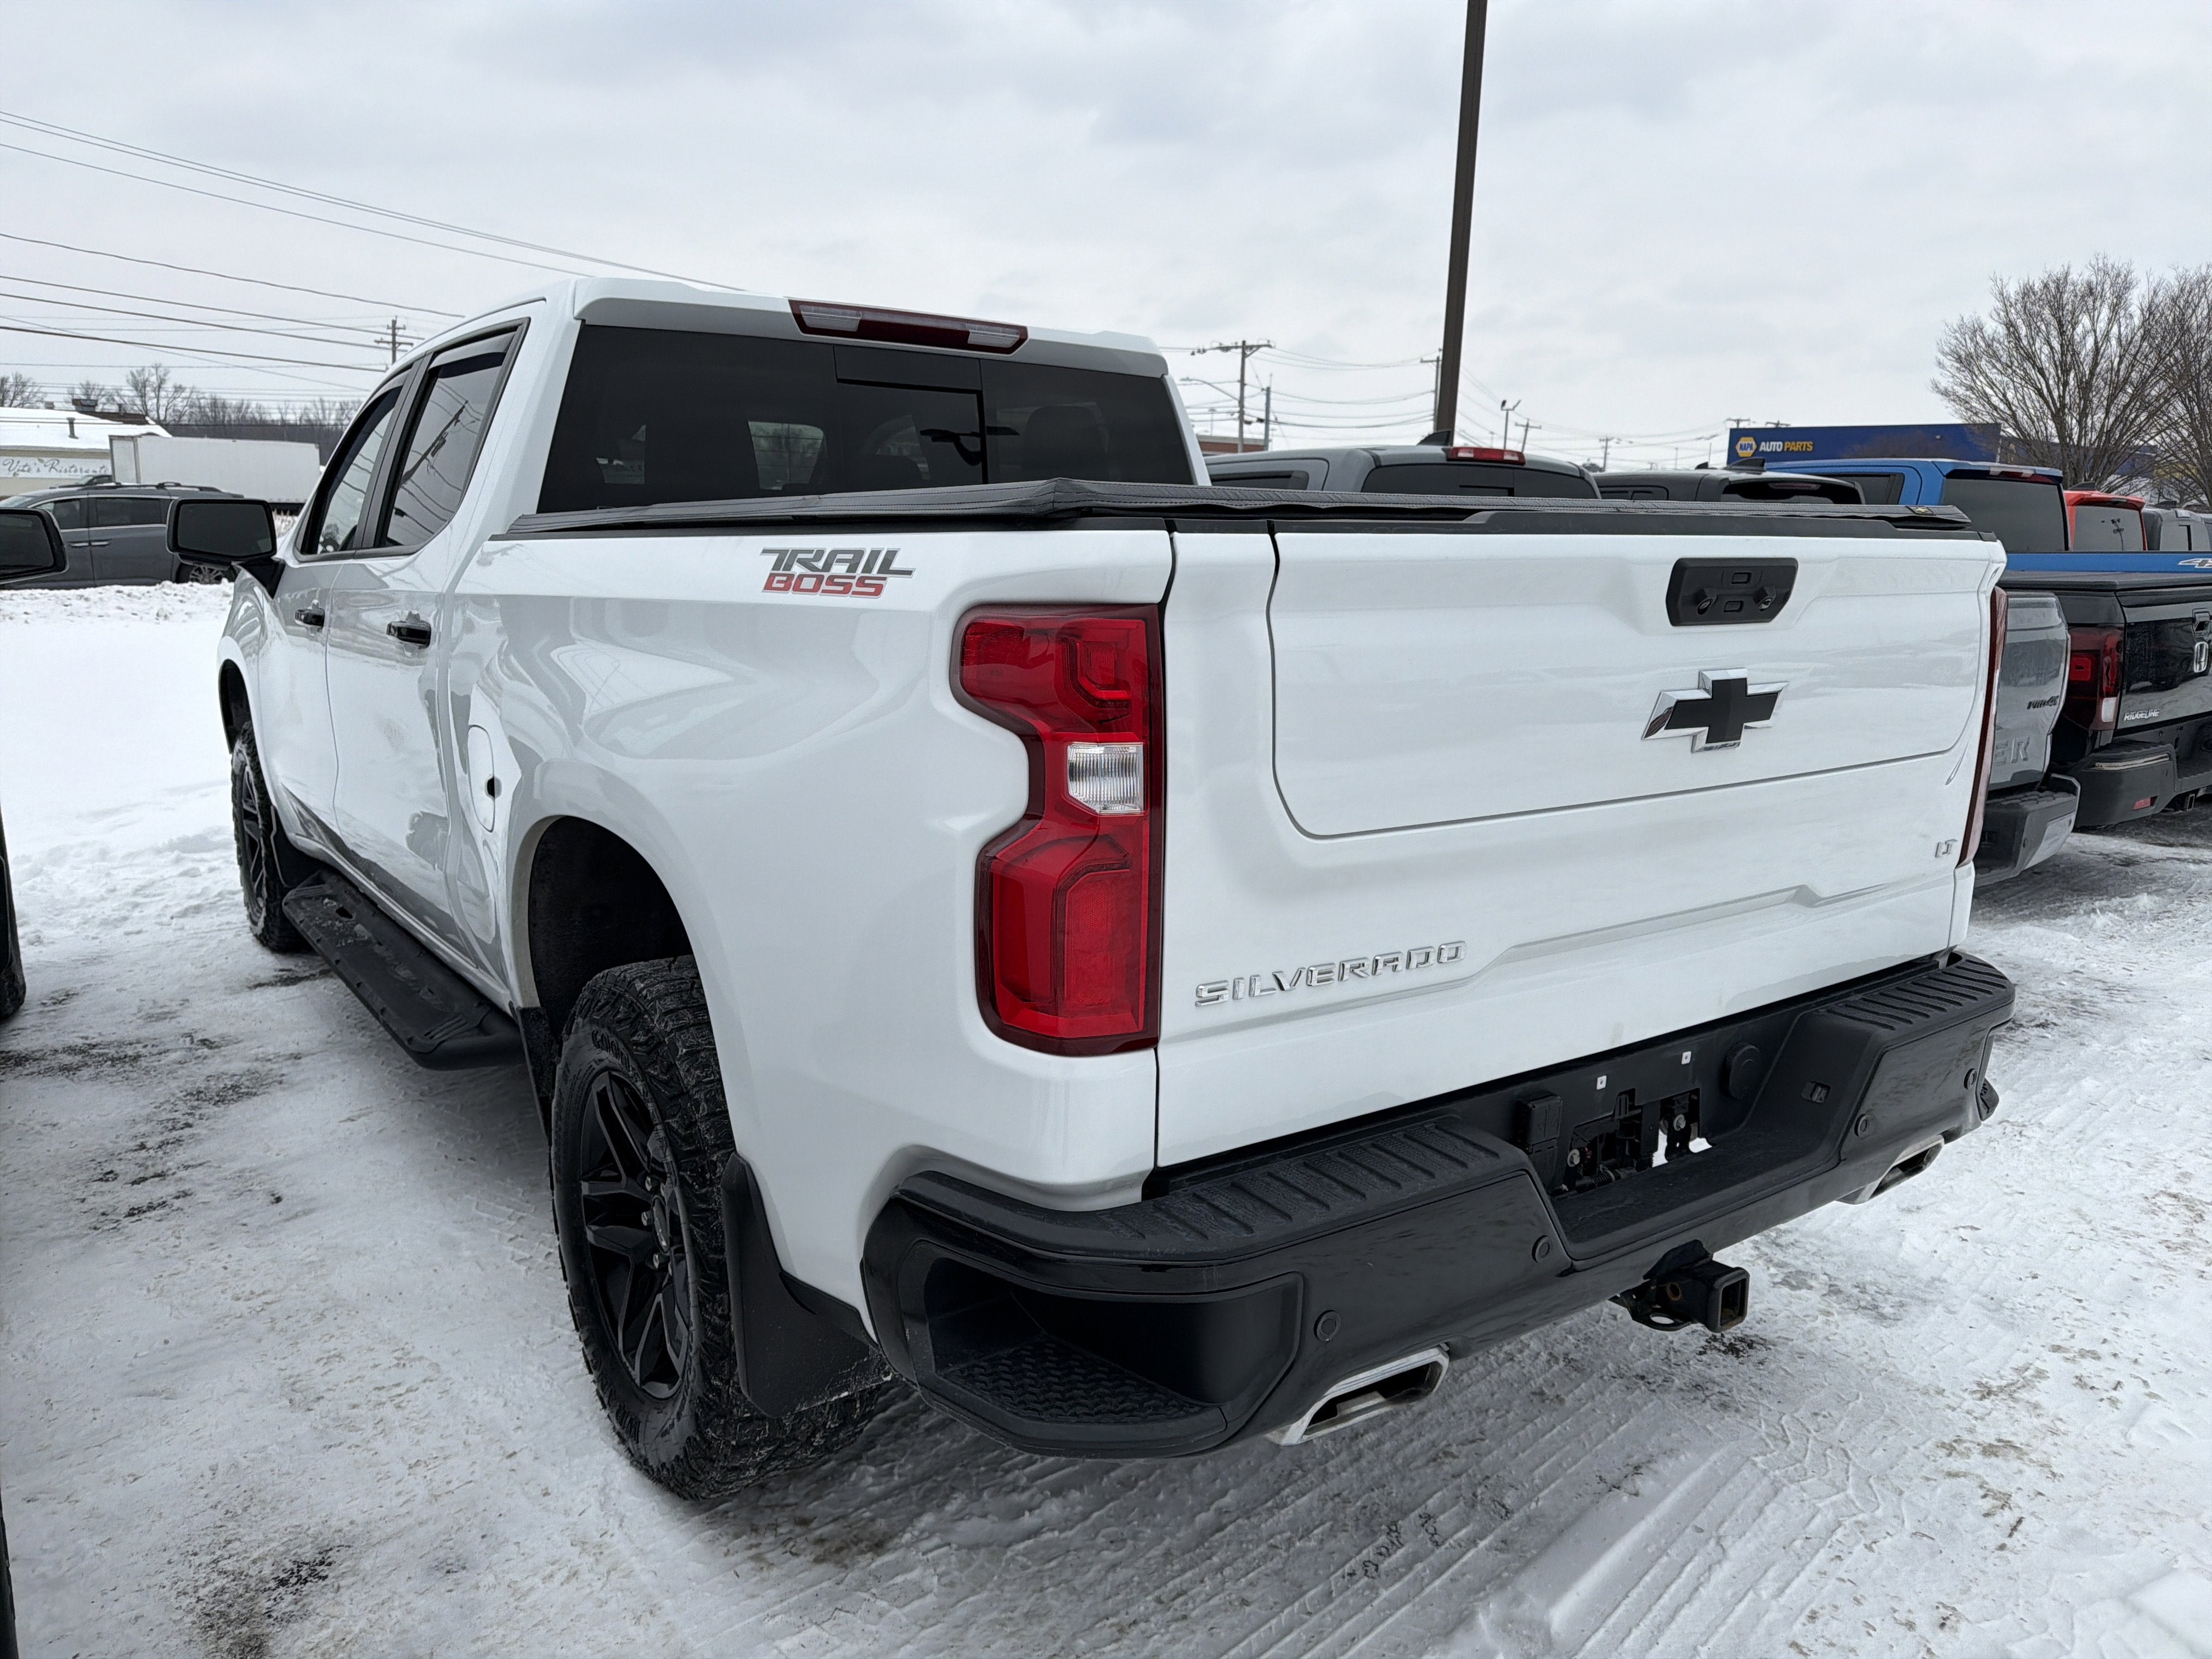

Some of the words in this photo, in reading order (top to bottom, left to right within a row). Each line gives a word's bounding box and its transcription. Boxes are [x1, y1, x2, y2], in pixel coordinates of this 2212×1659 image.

[1740, 442, 1753, 452] NAPA
[1759, 441, 1783, 452] AUTO
[1784, 441, 1813, 452] PARTS
[760, 547, 916, 578] TRAIL
[762, 572, 888, 599] BOSS
[2123, 708, 2160, 721] RIDGELINE
[1935, 838, 1958, 857] LT
[1195, 940, 1468, 1007] SILVERADO
